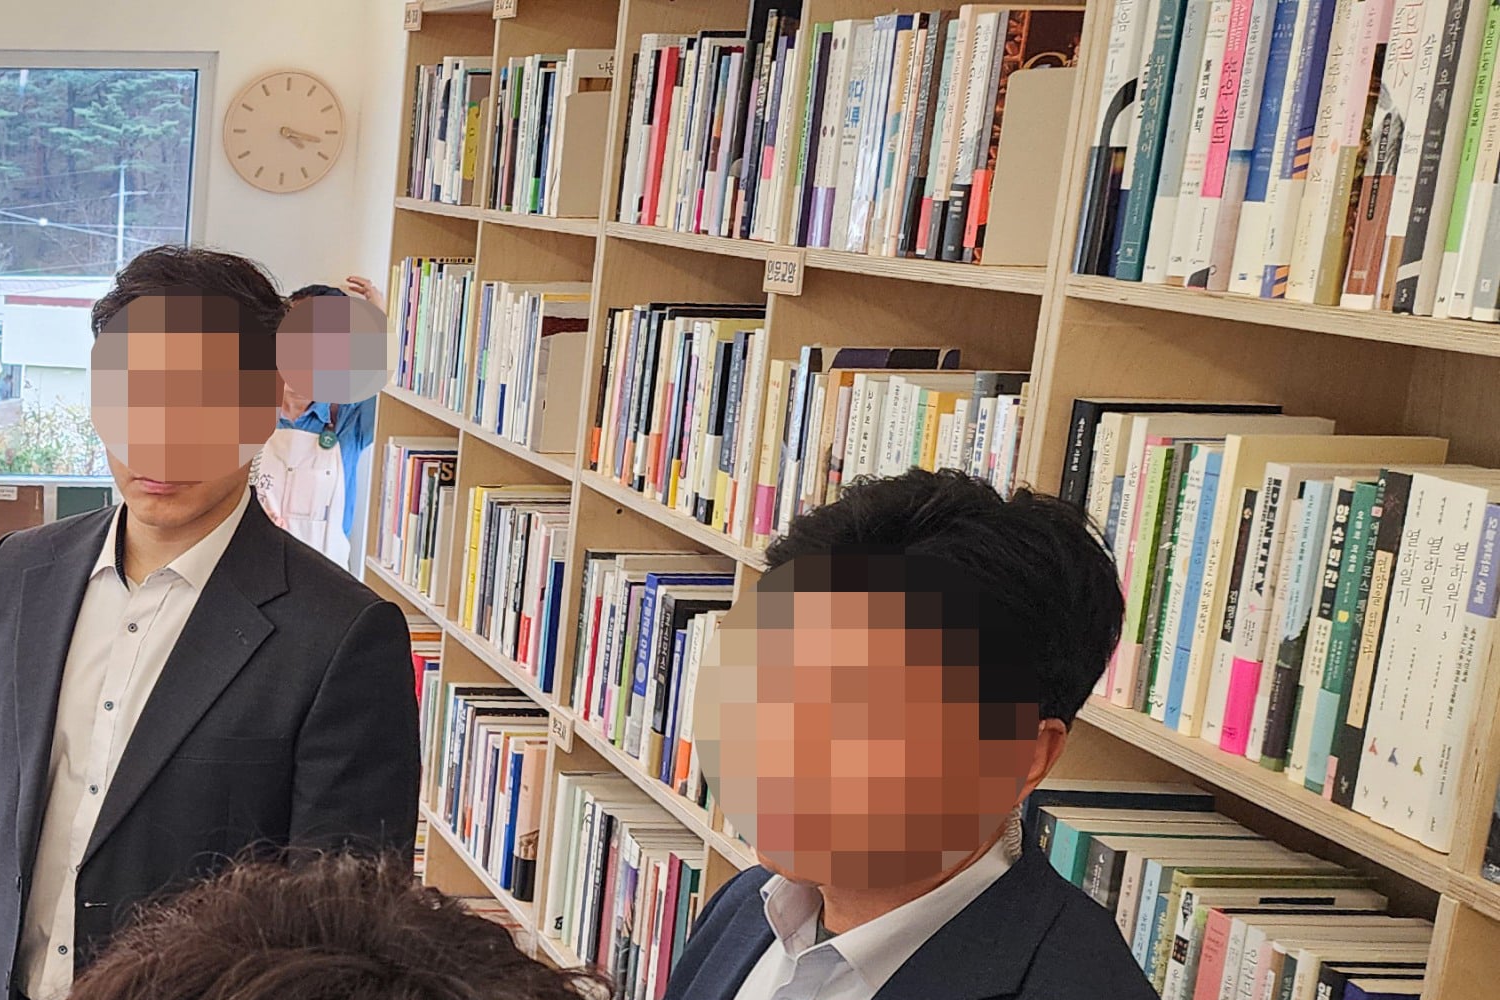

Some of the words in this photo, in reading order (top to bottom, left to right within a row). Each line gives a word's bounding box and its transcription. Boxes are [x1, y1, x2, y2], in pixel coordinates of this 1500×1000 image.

[1217, 55, 1238, 99] 불안
[1209, 104, 1231, 145] 세대
[1254, 477, 1282, 597] IDENTITY
[1476, 515, 1498, 578] 오늘부터의
[1472, 577, 1488, 605] 세계
[1441, 630, 1448, 641] 3
